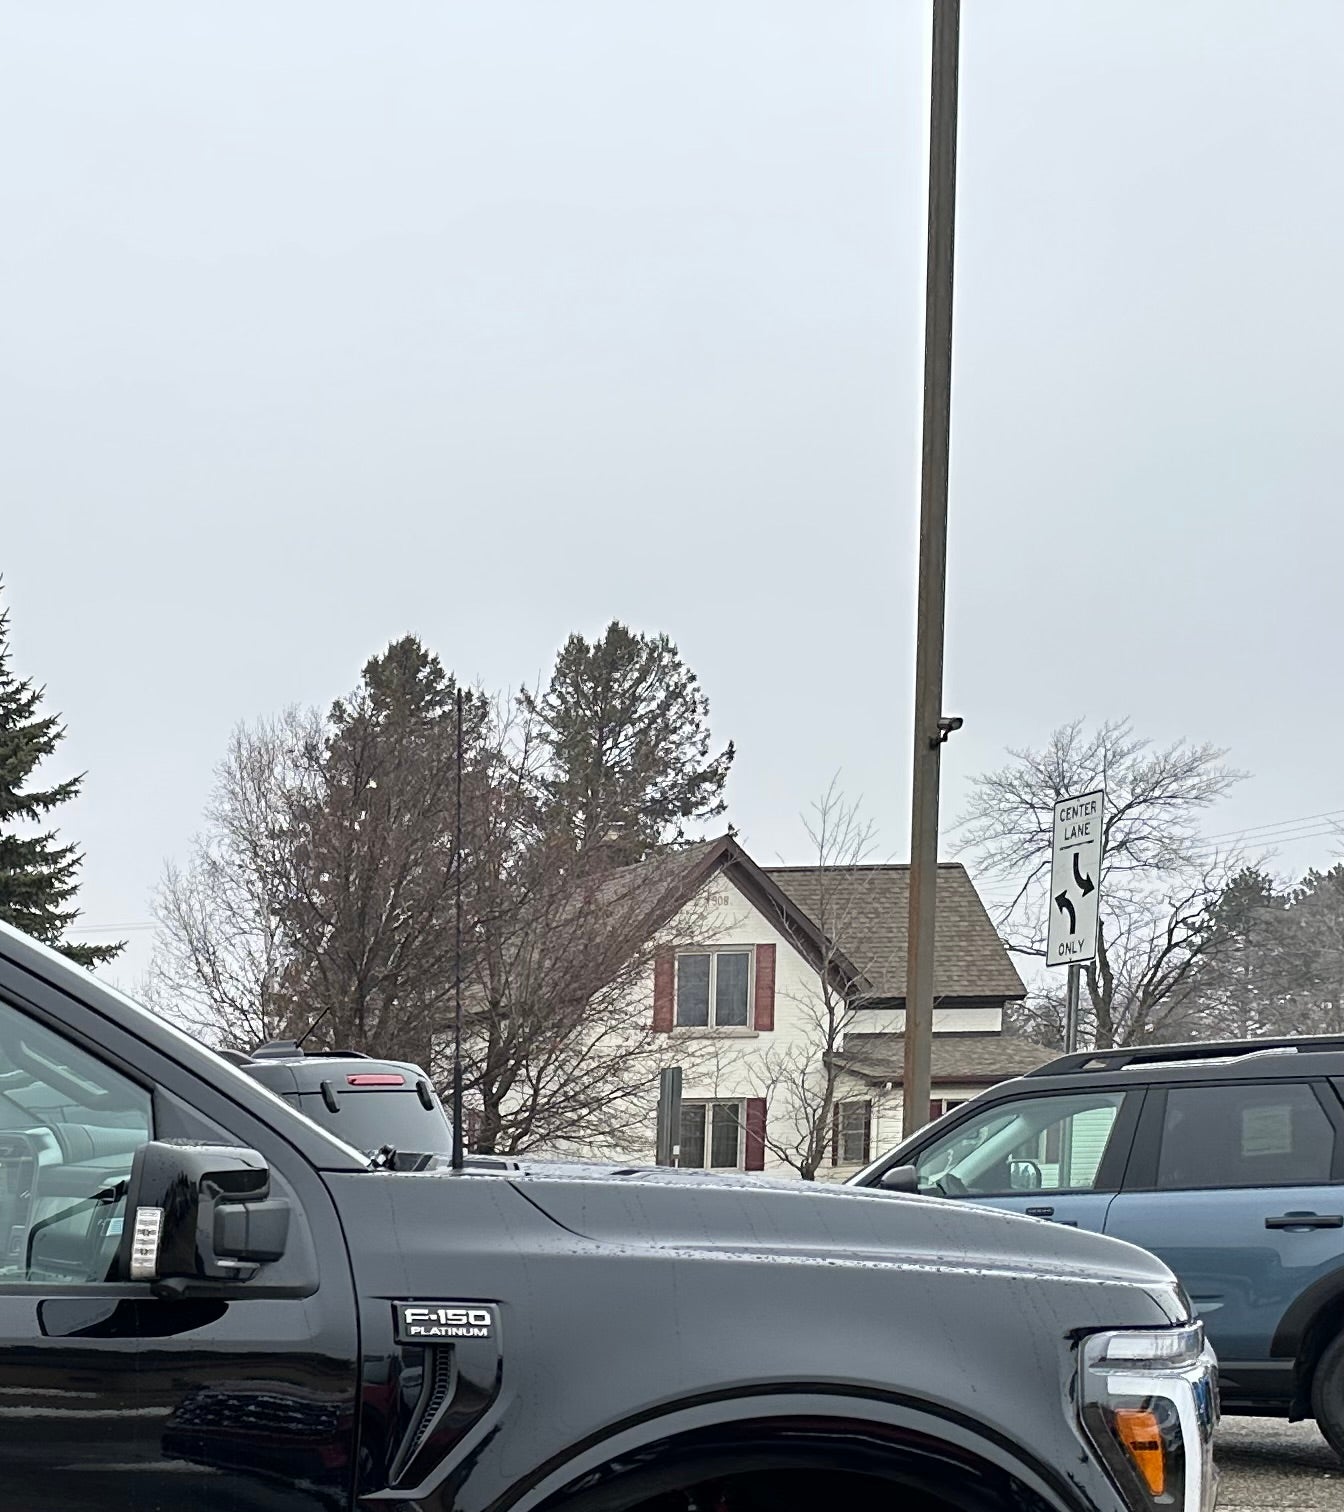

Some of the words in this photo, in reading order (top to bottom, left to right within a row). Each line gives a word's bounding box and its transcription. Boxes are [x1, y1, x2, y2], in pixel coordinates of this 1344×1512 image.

[1059, 800, 1097, 822] CENTER
[1064, 821, 1091, 841] LANE
[1058, 939, 1085, 957] ONLY
[404, 1308, 492, 1326] F-150
[411, 1326, 488, 1337] PLATINUM
